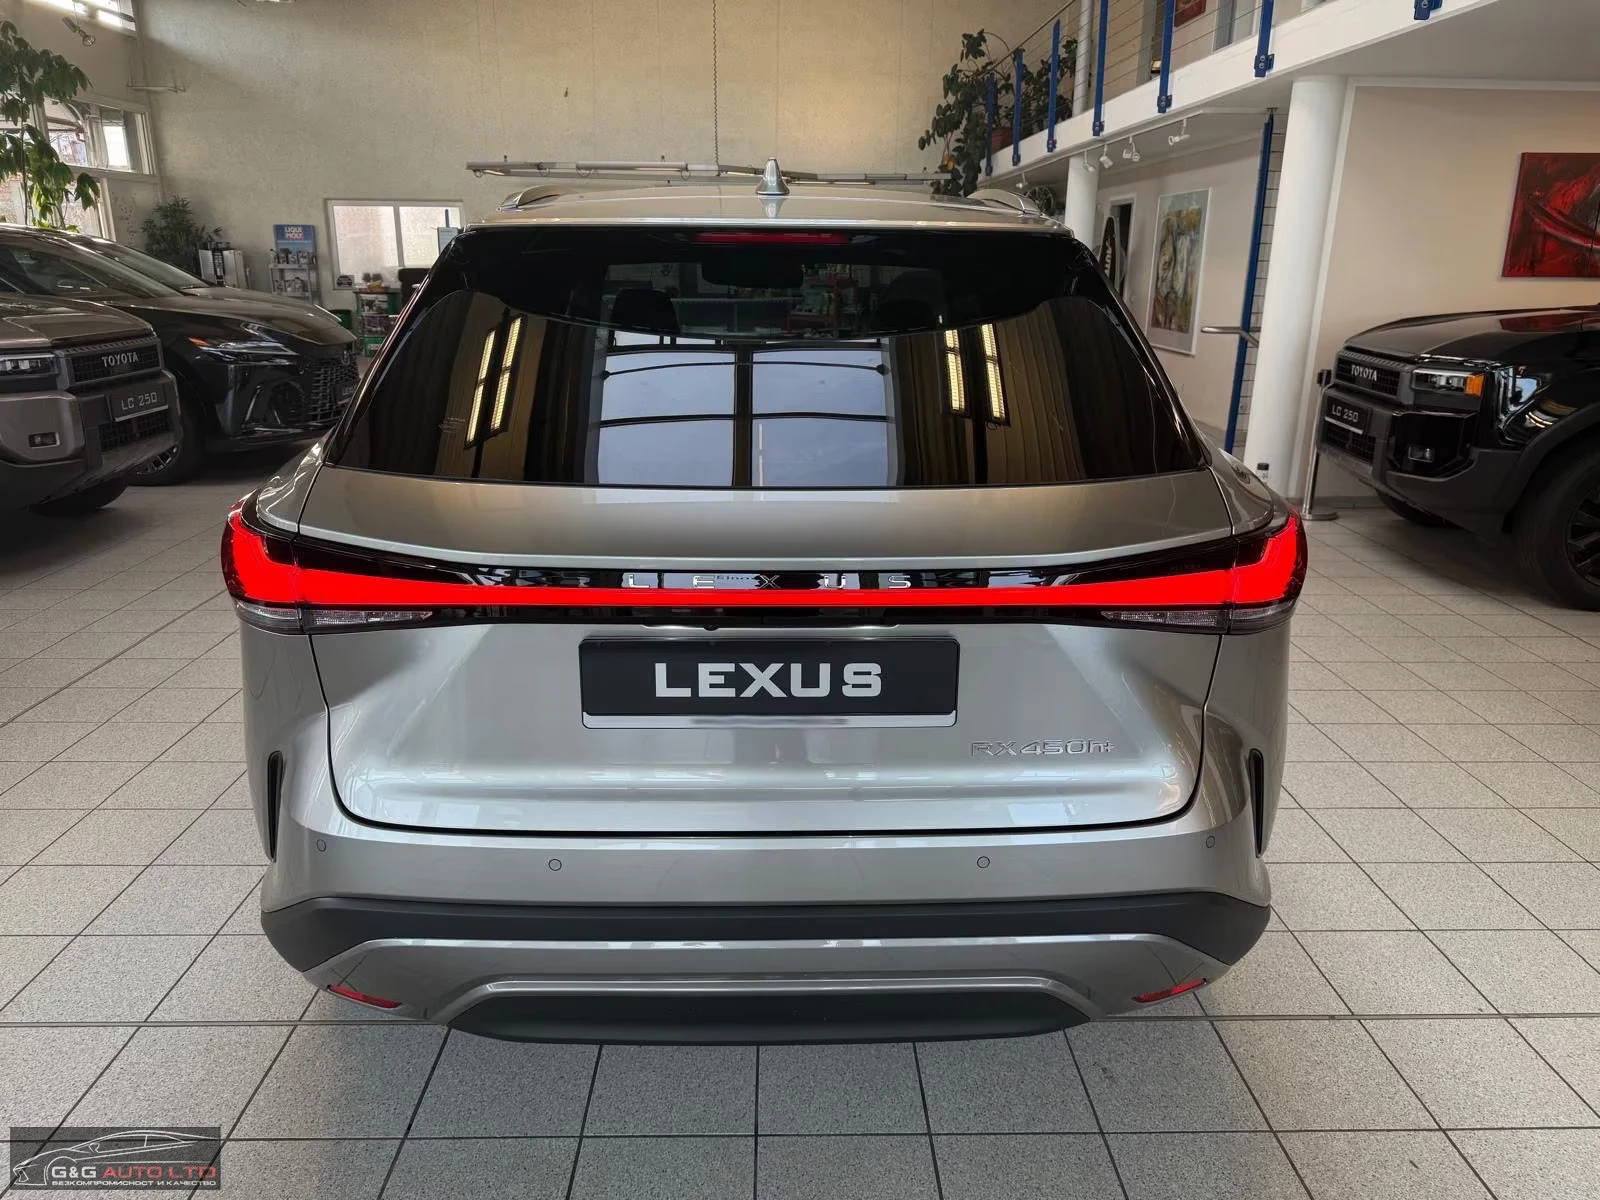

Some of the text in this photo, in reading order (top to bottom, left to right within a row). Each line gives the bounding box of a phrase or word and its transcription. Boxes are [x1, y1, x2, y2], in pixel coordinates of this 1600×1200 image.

[102, 352, 139, 367] TOYOTA
[1351, 364, 1377, 381] TOYOTA
[121, 392, 157, 411] LC 250
[1332, 405, 1358, 422] LC 250
[628, 574, 912, 589] LEXUS
[654, 662, 882, 698] LEXUS
